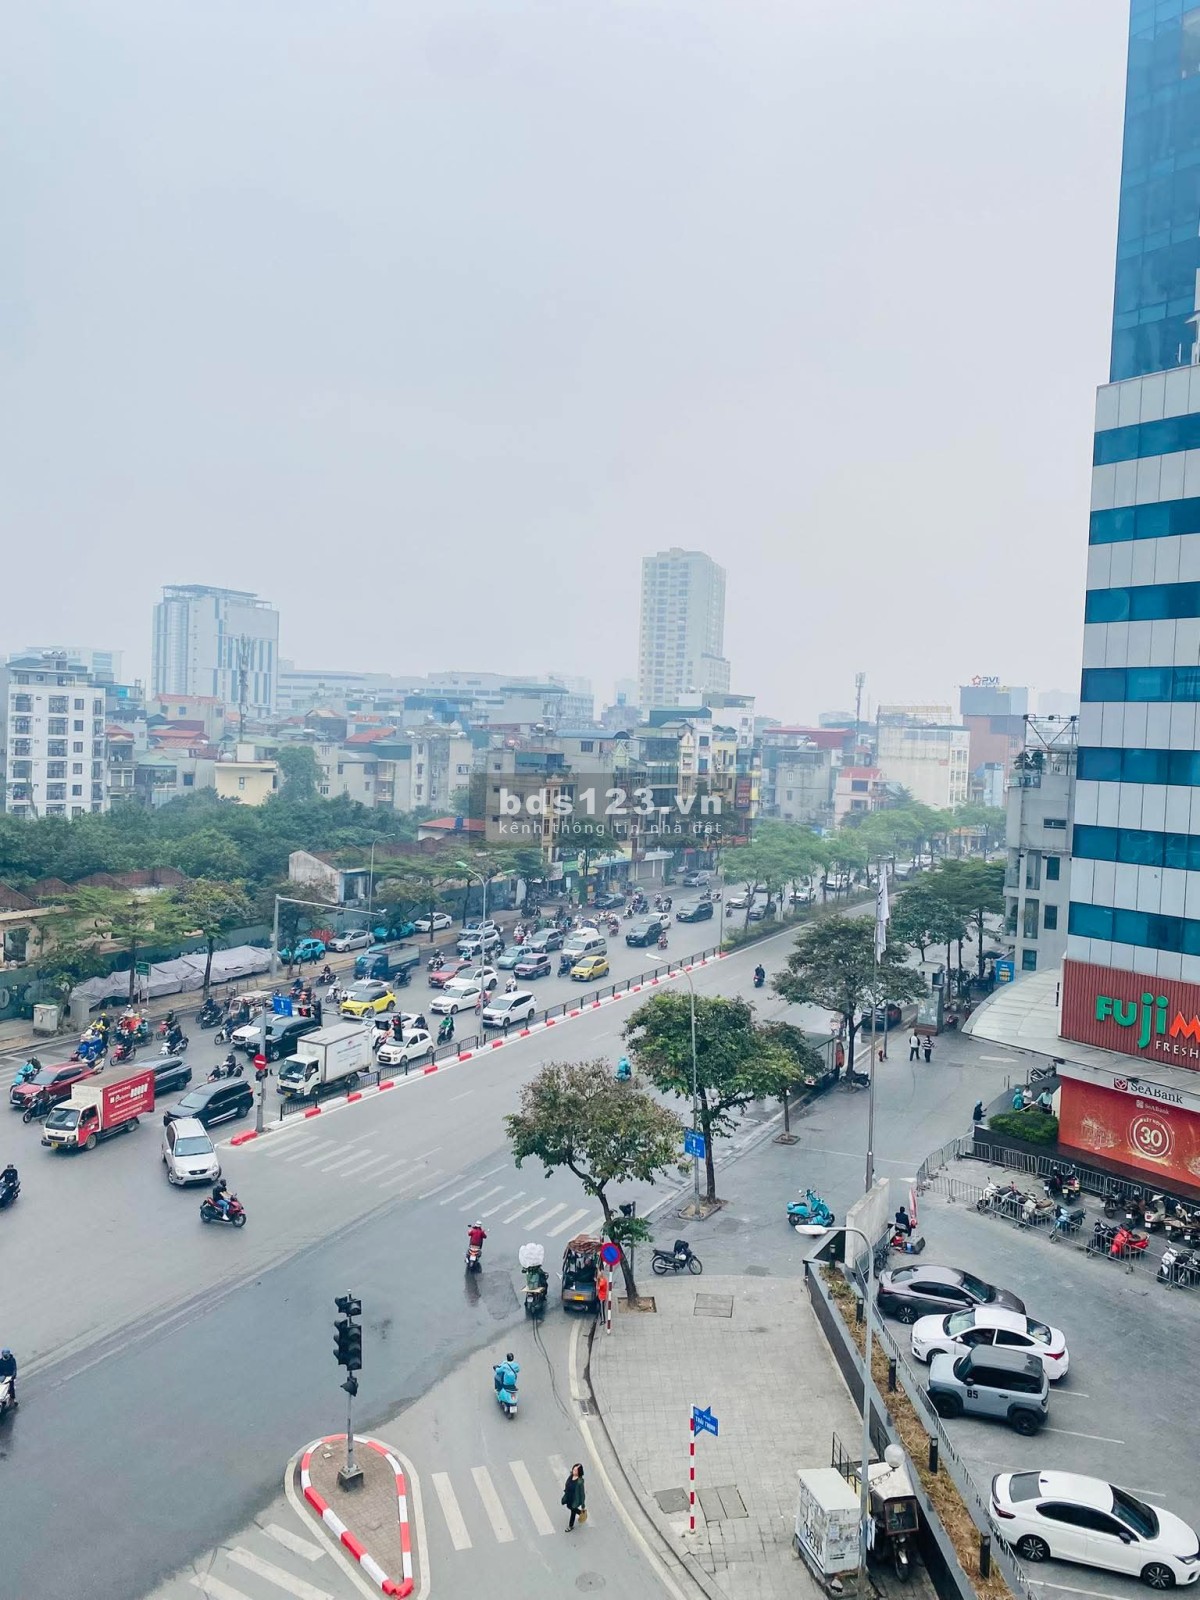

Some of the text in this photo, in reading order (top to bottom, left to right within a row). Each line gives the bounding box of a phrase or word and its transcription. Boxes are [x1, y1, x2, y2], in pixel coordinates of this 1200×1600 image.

[1155, 1040, 1199, 1059] FRESH
[1130, 1082, 1184, 1104] SeABank
[1140, 1126, 1163, 1148] 30
[967, 1389, 979, 1399] 85
